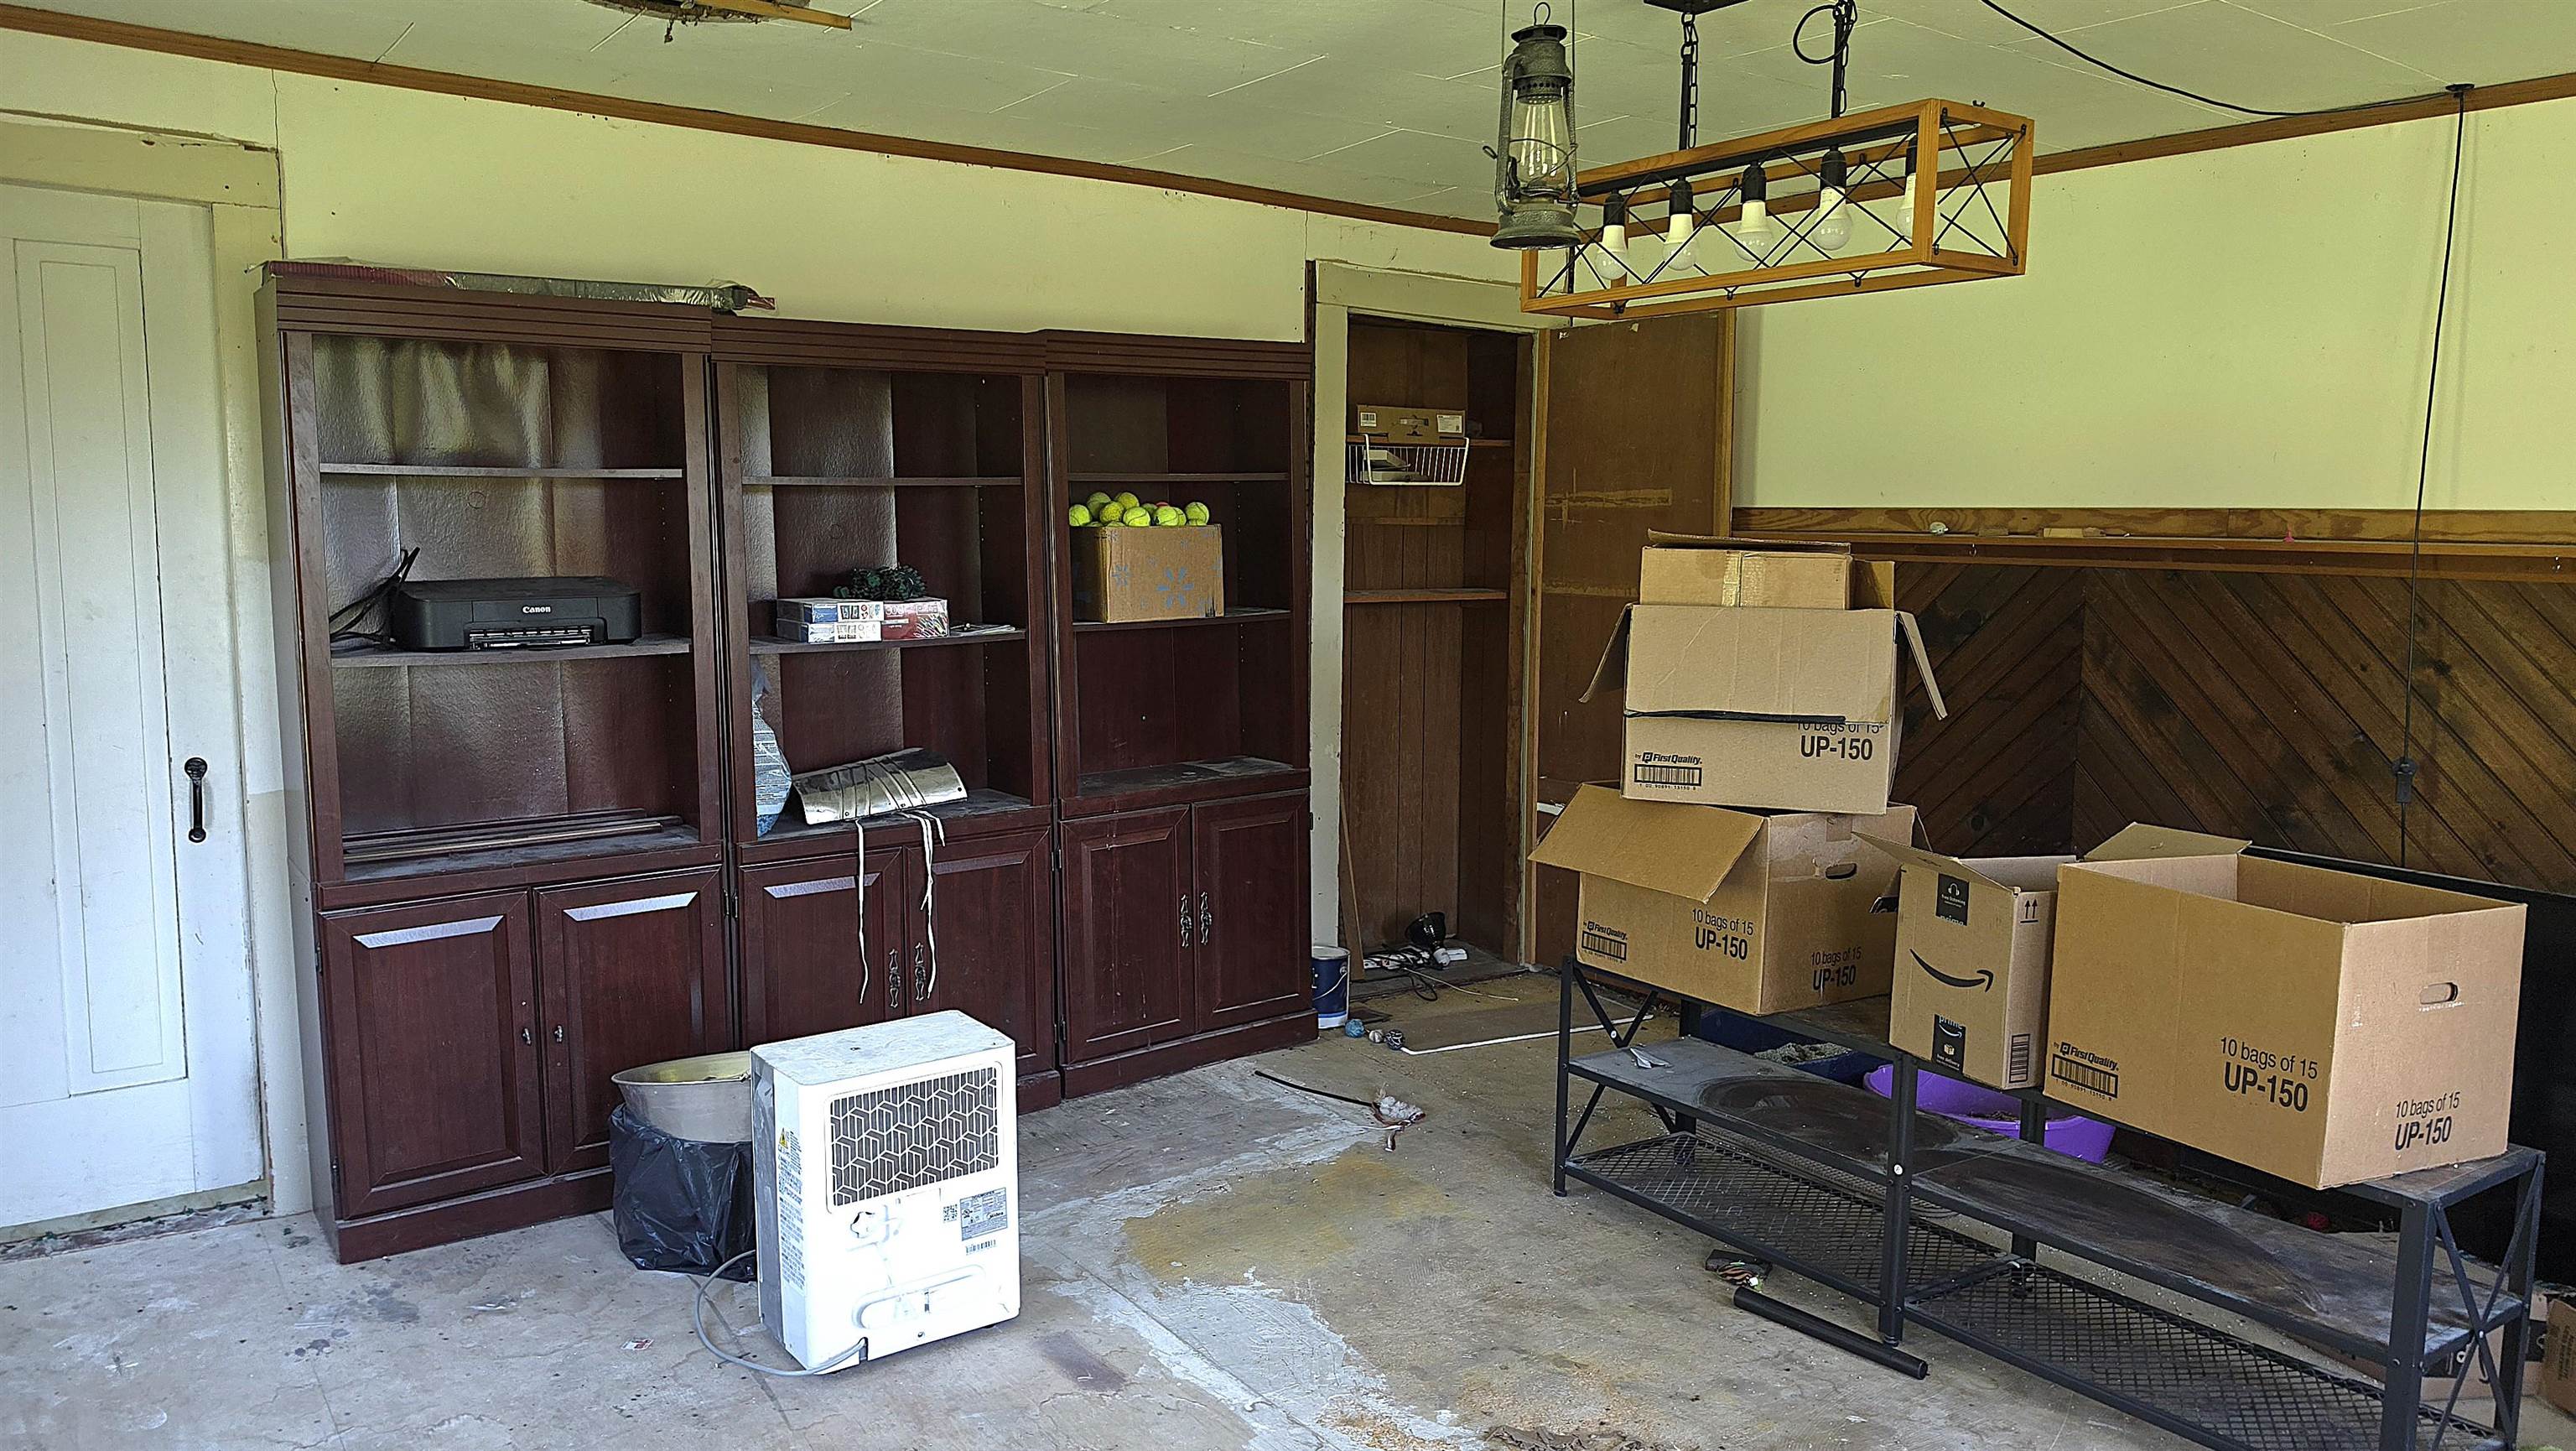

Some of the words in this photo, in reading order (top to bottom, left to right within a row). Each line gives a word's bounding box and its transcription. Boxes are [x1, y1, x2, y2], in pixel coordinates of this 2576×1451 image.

[1801, 735, 1873, 760] UP-150
[1692, 908, 1703, 923] 10
[1705, 911, 1727, 931] bags
[1730, 918, 1740, 932] of
[1742, 920, 1753, 935] 15
[1696, 927, 1748, 960] UP-150
[1811, 952, 1820, 965] 10
[1822, 951, 1841, 966] bags
[1852, 946, 1862, 960] 15
[1813, 965, 1856, 992] UP-150
[2221, 1037, 2237, 1056] 10
[2241, 1042, 2276, 1069] bags
[2280, 1055, 2296, 1073] of
[2300, 1058, 2318, 1079] 15
[2225, 1062, 2308, 1111] UP-150
[2397, 1100, 2408, 1118] 10
[2409, 1099, 2434, 1118] bags
[2436, 1093, 2447, 1111] of
[2449, 1091, 2460, 1109] 15
[2395, 1116, 2452, 1150] UP-150
